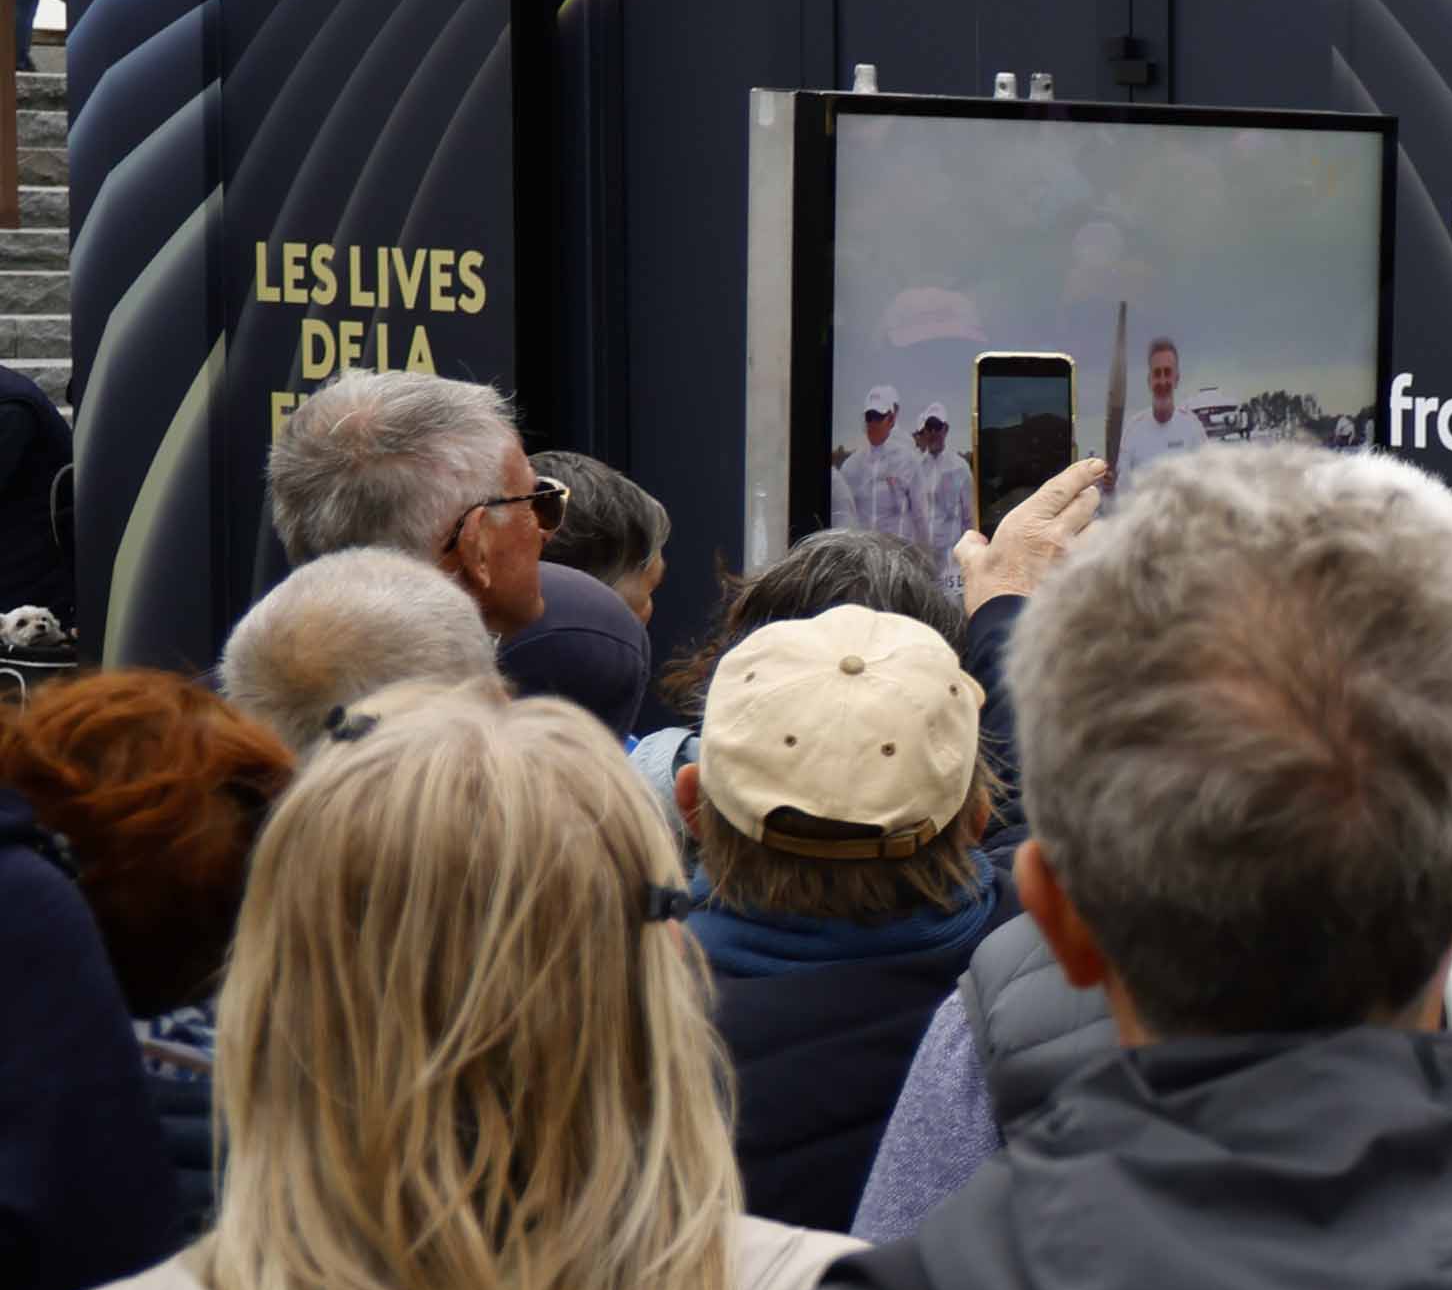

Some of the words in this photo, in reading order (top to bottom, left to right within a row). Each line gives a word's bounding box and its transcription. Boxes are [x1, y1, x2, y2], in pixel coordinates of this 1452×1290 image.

[255, 241, 338, 306] LES
[350, 245, 486, 314] LIVES
[302, 317, 365, 381] DE
